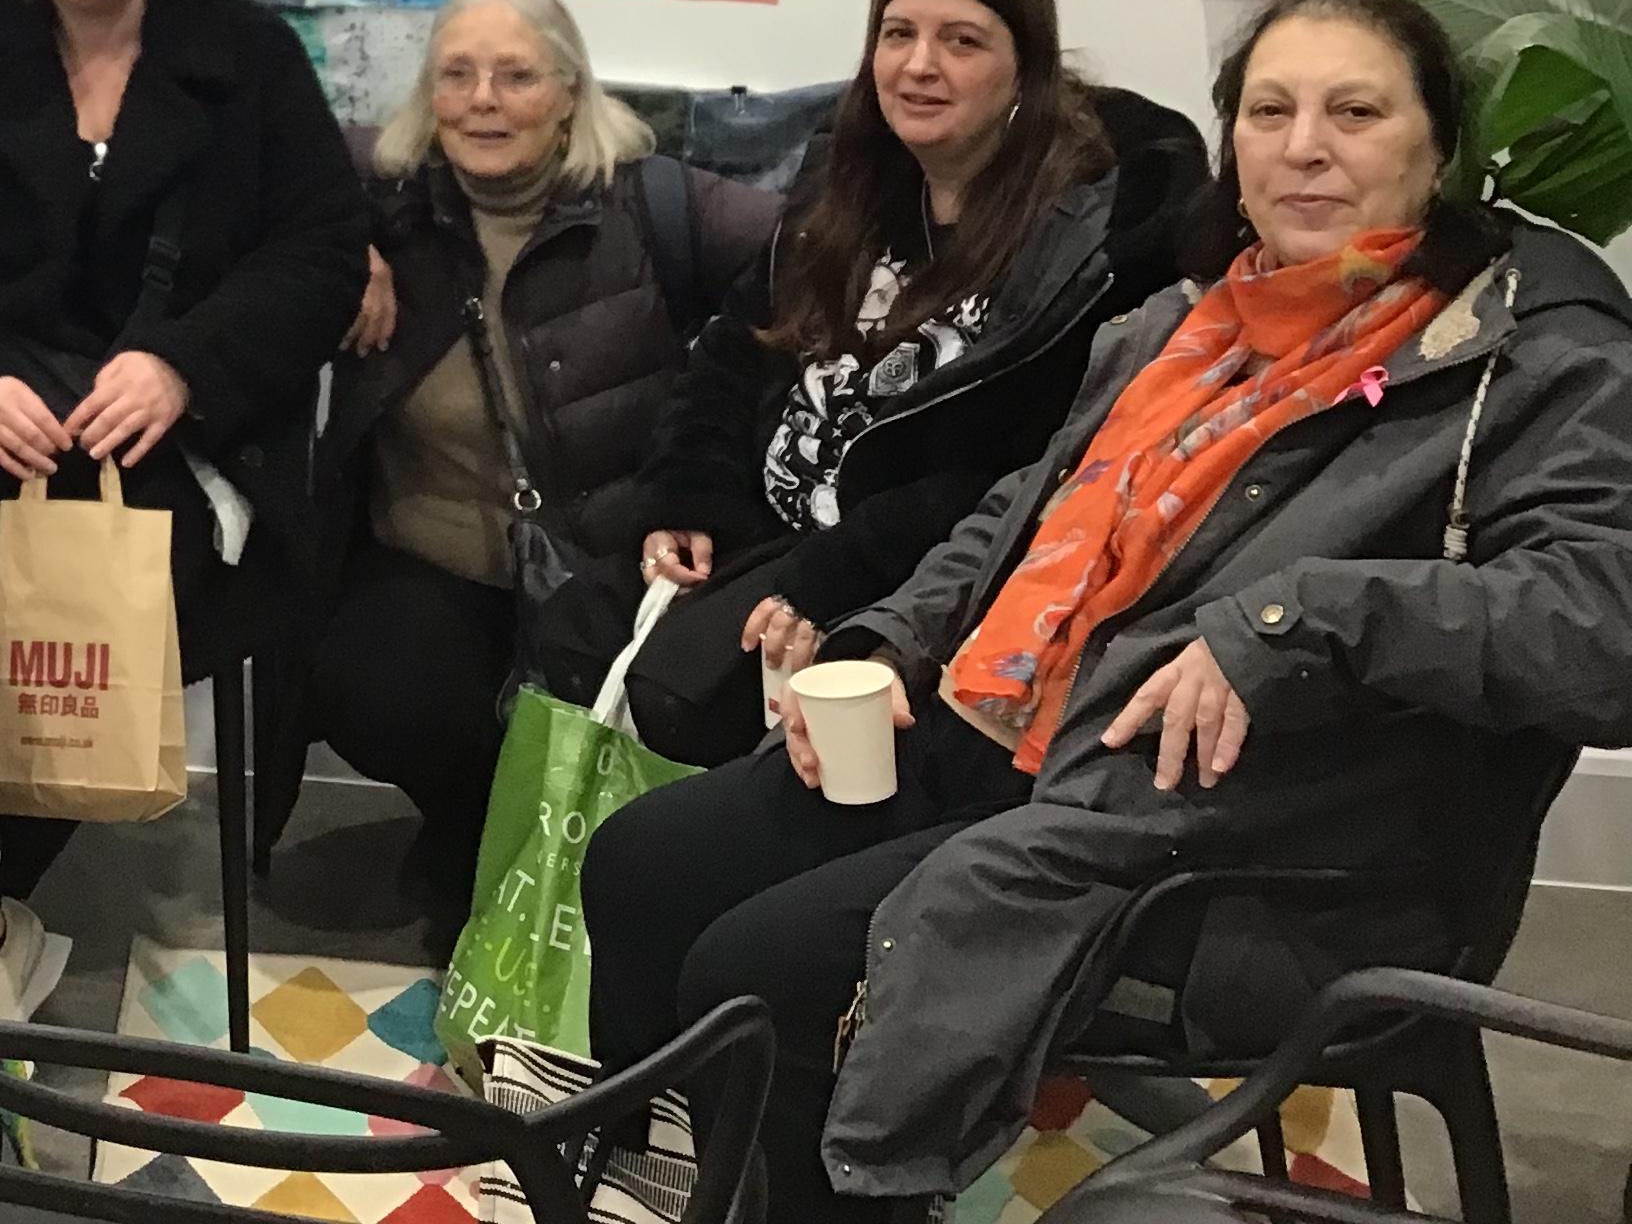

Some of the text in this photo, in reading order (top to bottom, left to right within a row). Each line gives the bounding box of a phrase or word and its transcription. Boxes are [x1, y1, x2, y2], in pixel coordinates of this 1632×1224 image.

[9, 641, 109, 690] MUJI
[18, 693, 99, 719] 無印良品
